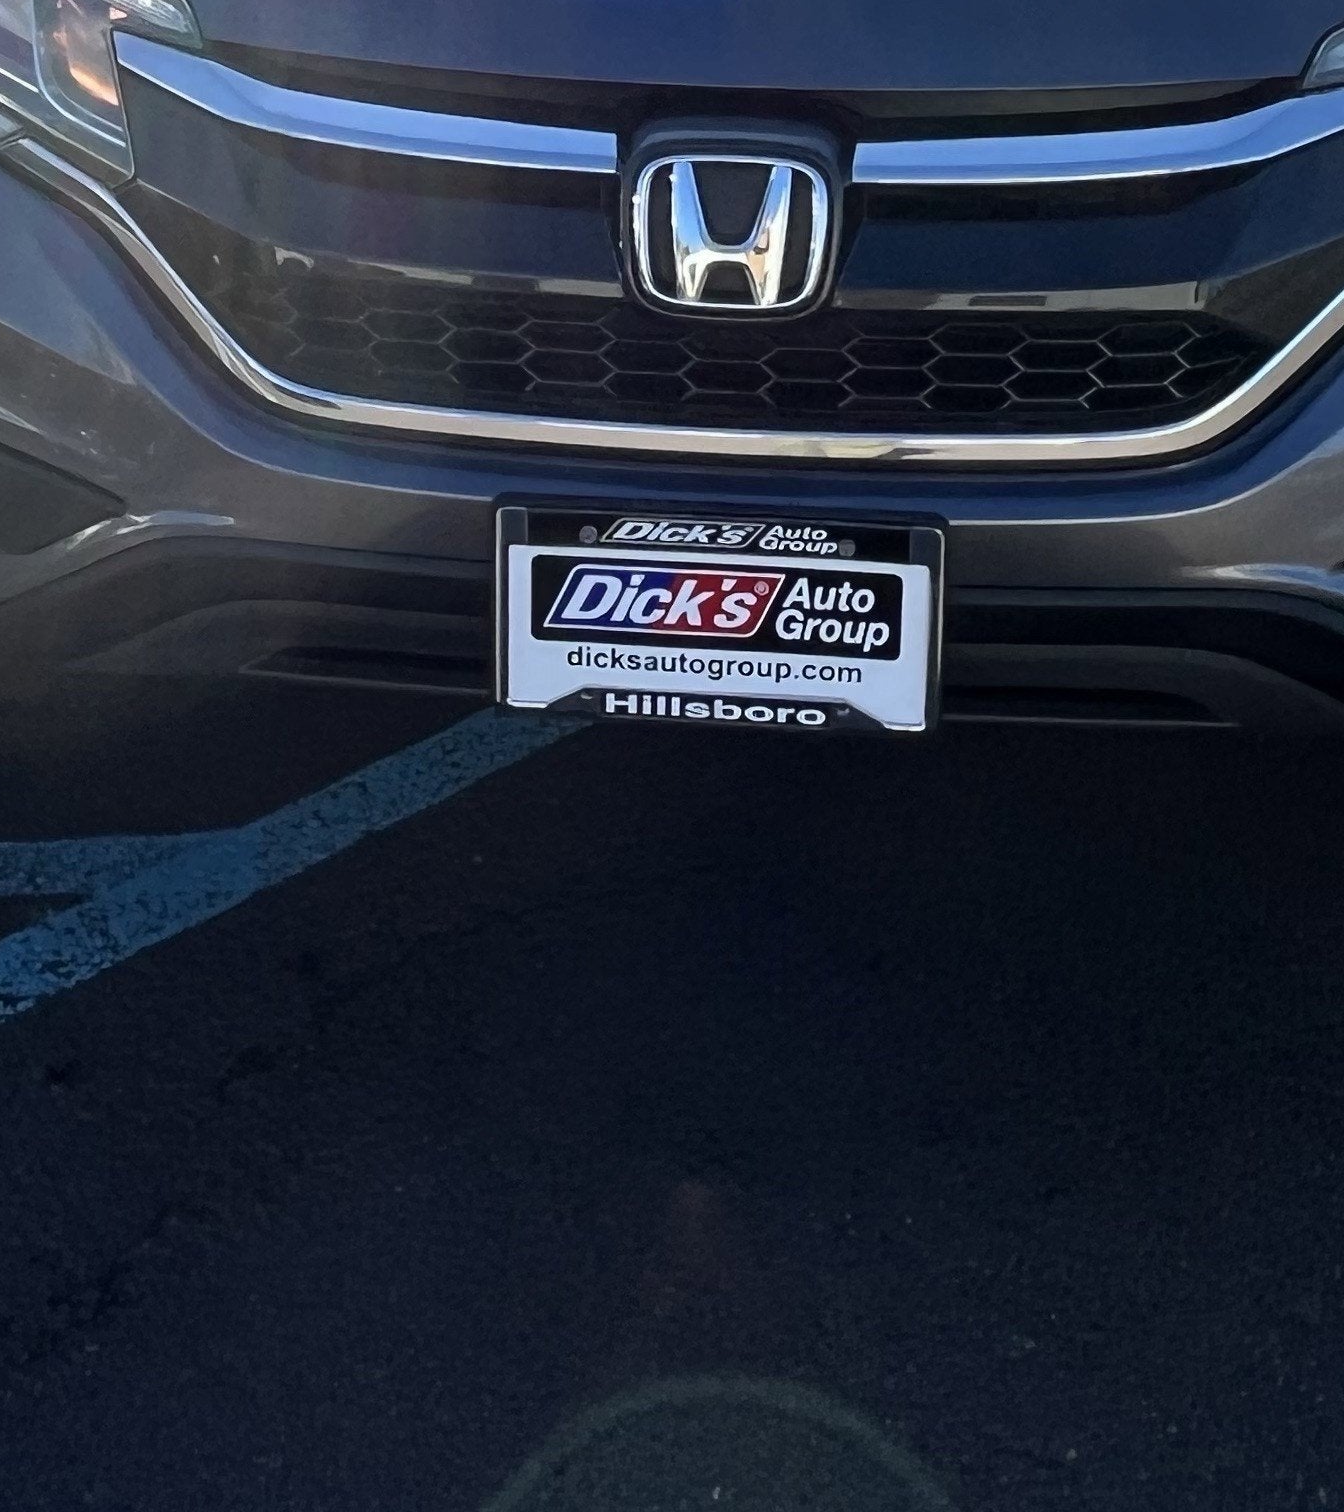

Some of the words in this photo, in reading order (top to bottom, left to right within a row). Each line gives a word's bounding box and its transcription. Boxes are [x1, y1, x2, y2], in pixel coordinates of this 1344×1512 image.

[612, 520, 747, 546] Dick's
[758, 538, 839, 555] Group
[765, 524, 829, 541] Auto
[560, 573, 757, 630] Dick's
[782, 577, 876, 613] Auto
[775, 608, 891, 653] Group
[566, 645, 862, 684] dicksautogroup.com
[605, 692, 827, 726] Hillsboro
